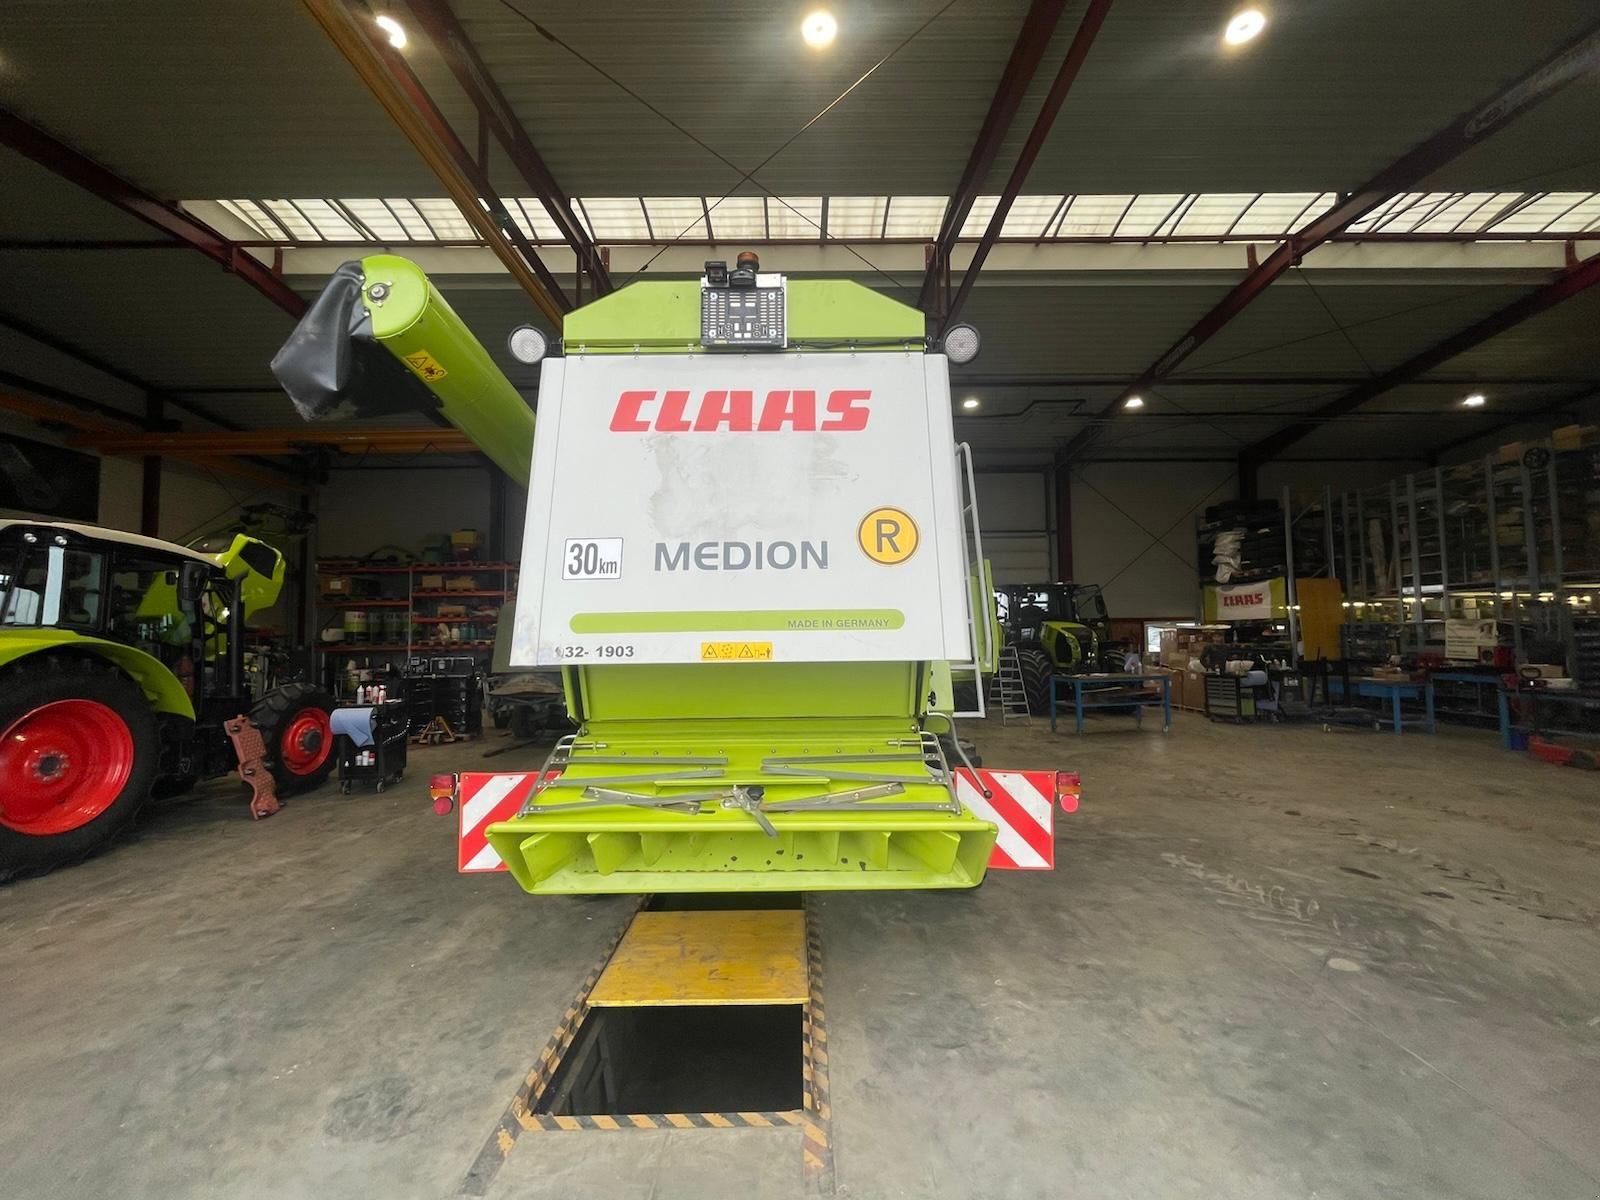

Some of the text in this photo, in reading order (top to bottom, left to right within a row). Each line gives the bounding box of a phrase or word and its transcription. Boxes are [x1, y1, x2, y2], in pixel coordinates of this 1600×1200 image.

[610, 390, 872, 432] CLAAS
[875, 519, 901, 553] R
[654, 540, 828, 571] MEDION
[1223, 593, 1263, 607] CLAAS
[788, 619, 890, 628] MADE IN GERMANY
[596, 646, 634, 657] 1903
